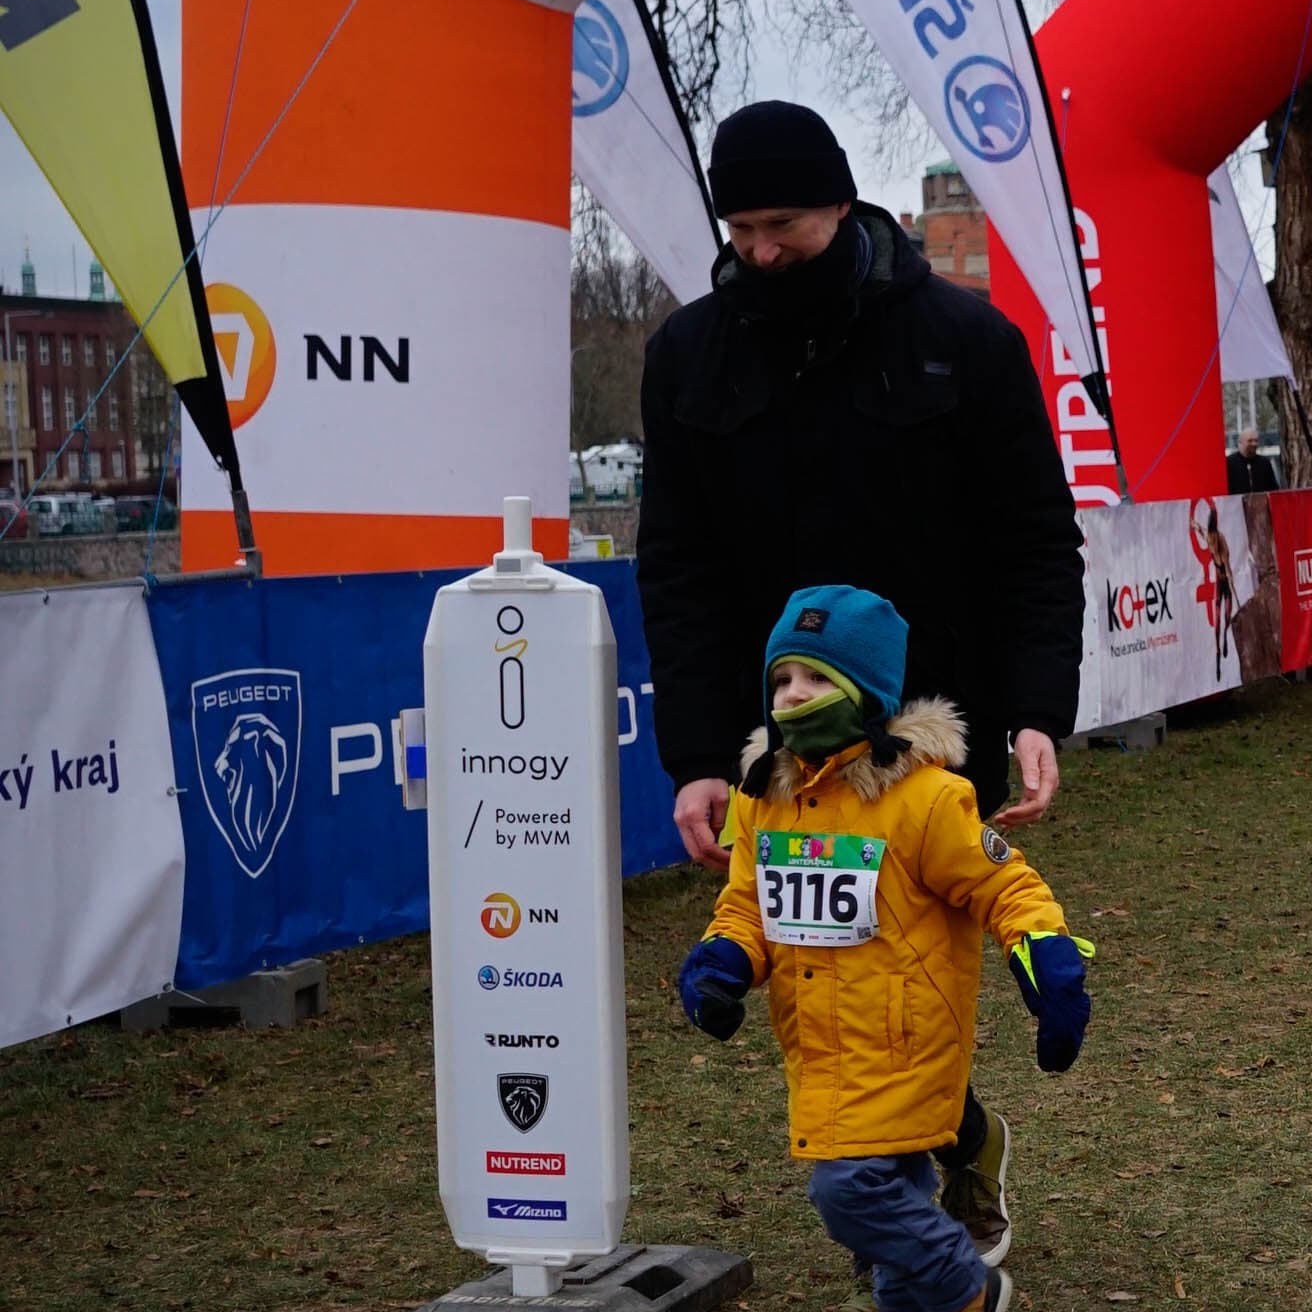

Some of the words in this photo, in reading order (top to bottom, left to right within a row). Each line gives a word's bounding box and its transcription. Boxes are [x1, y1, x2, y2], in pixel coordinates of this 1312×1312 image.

[303, 333, 410, 384] NN
[1106, 577, 1173, 633] kotex
[203, 685, 292, 712] PEUGEOT
[51, 740, 120, 793] kraj
[461, 747, 569, 780] innogy
[495, 808, 570, 824] Powered
[496, 829, 516, 849] by
[524, 830, 570, 845] MVM
[764, 869, 858, 923] 3116
[529, 909, 559, 924] NN
[503, 968, 563, 988] ŠKODA
[498, 1034, 560, 1048] RUNTO
[490, 1155, 562, 1171] NUTREND
